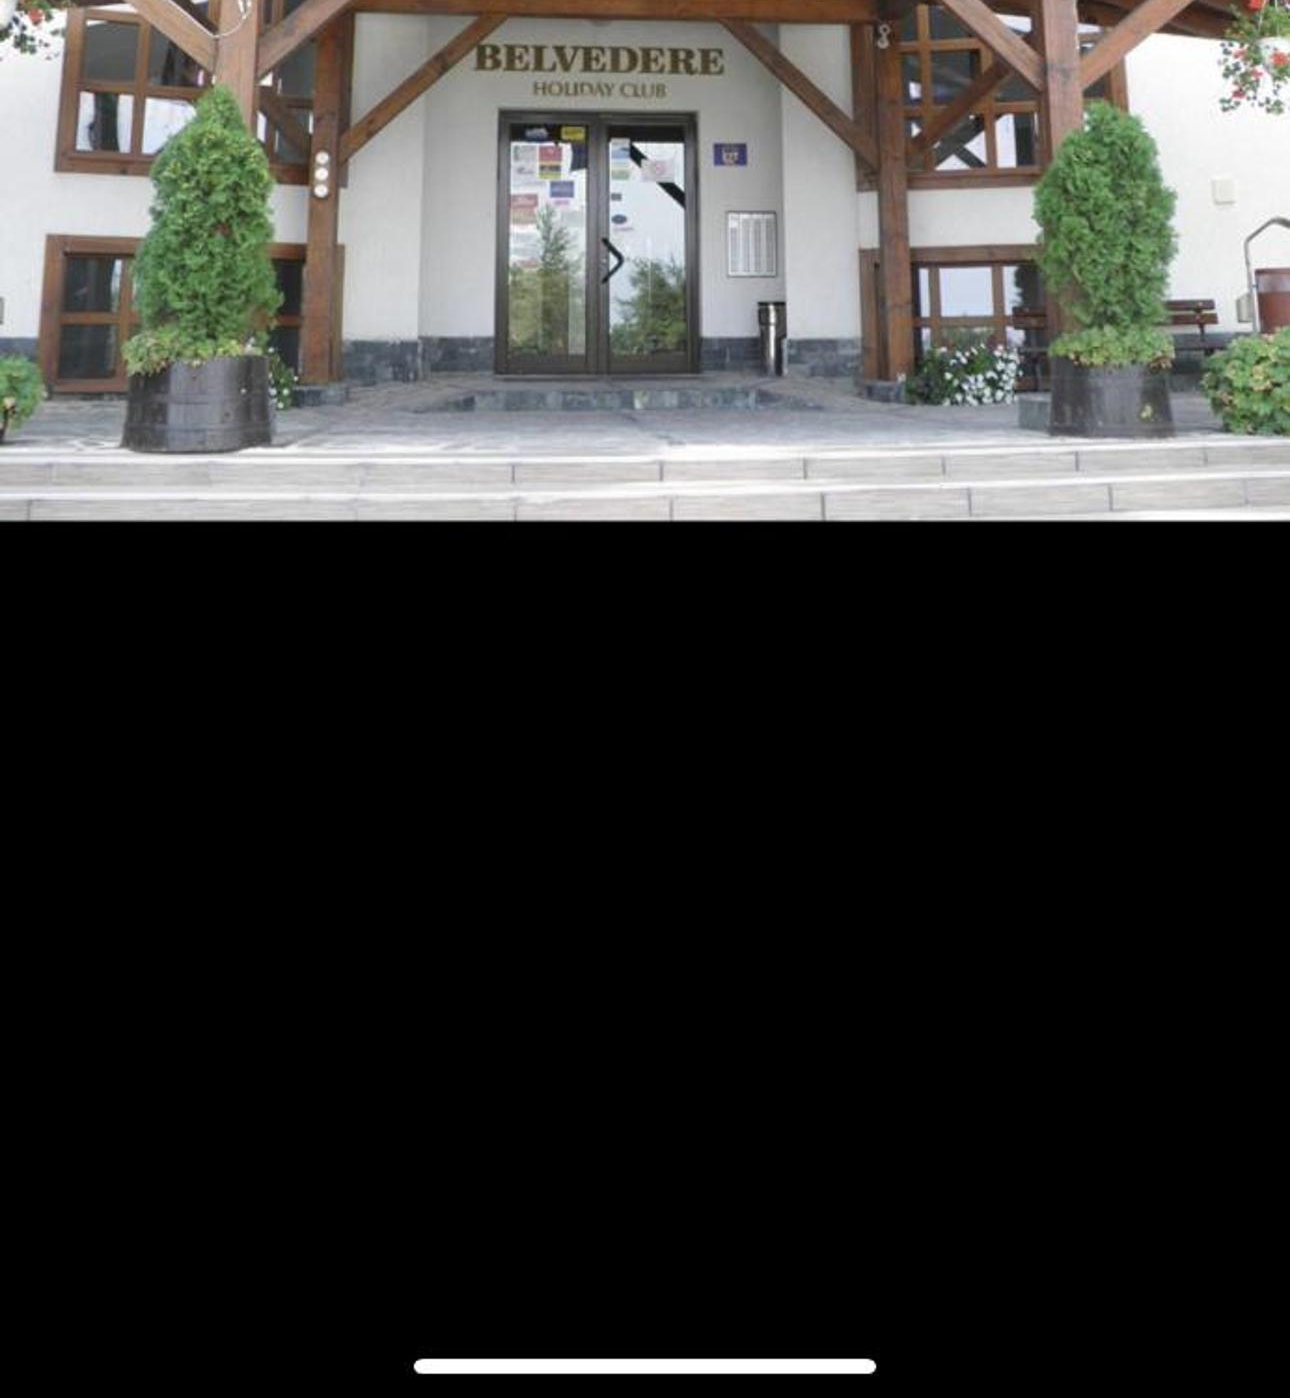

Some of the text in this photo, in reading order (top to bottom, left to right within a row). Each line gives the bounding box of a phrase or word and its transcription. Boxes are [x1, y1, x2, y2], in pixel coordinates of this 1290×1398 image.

[474, 44, 725, 76] BELVEDERE
[534, 81, 667, 98] HOLIDAY CLUB
